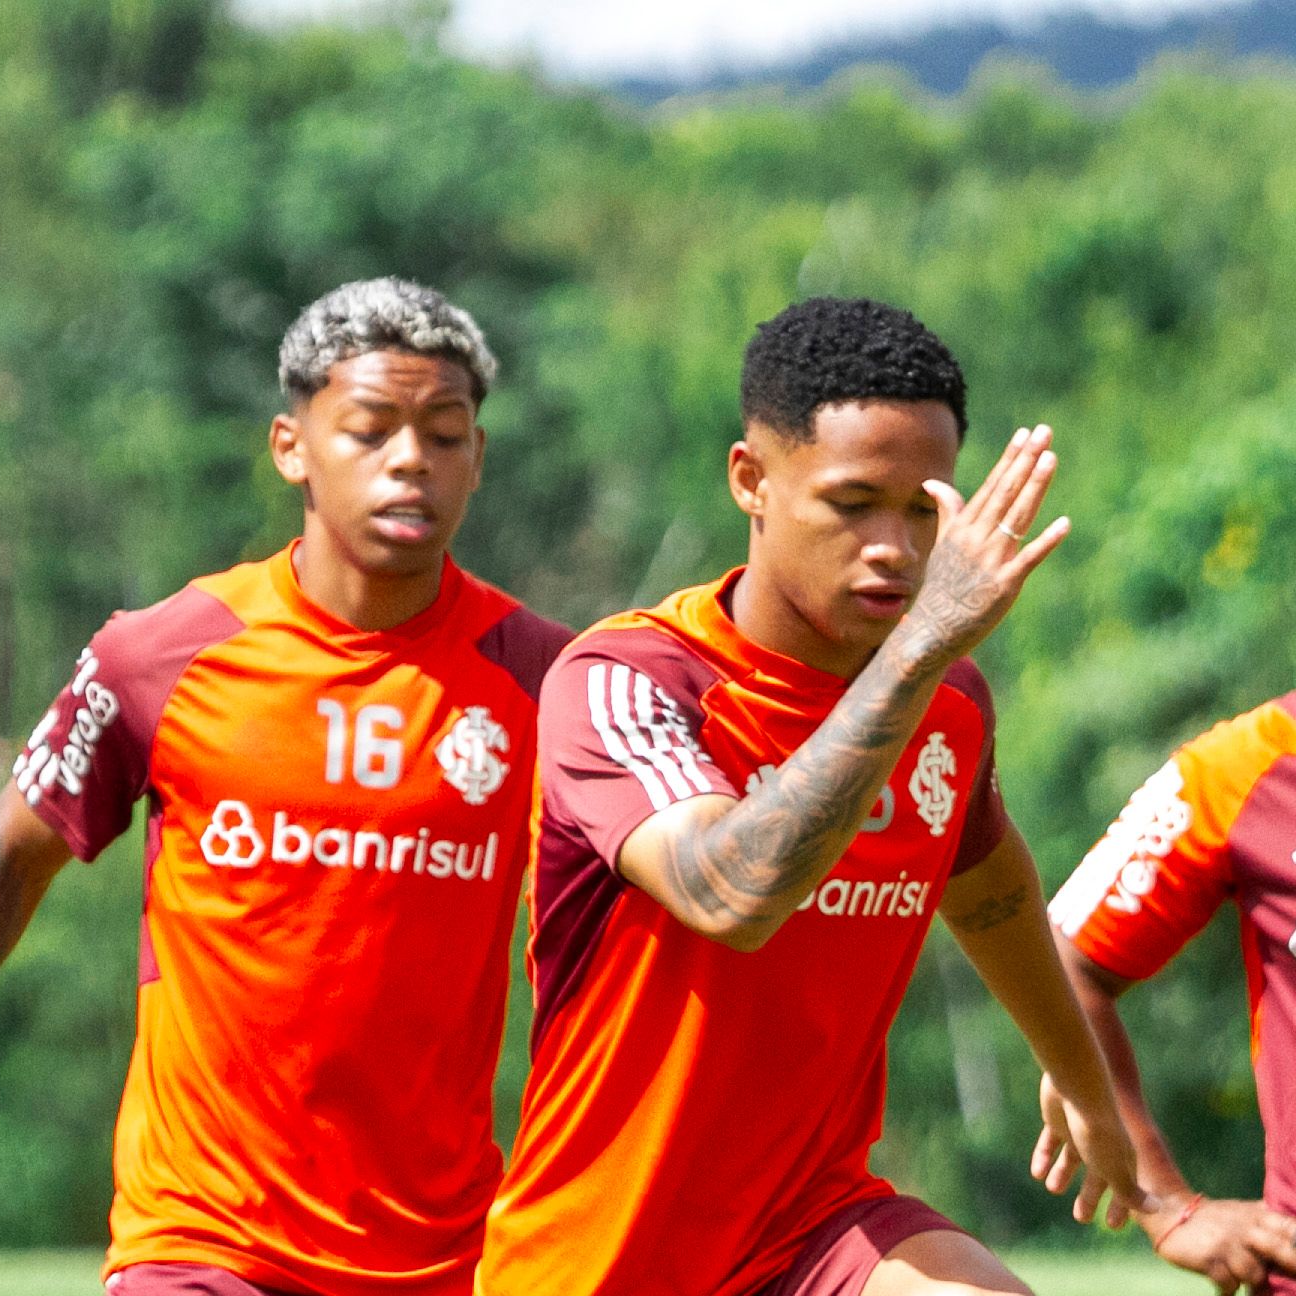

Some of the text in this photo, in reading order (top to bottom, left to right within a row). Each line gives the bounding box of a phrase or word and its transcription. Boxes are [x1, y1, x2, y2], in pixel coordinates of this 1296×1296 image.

[55, 708, 103, 795] vero
[317, 698, 402, 788] 16
[271, 812, 499, 881] banrisul
